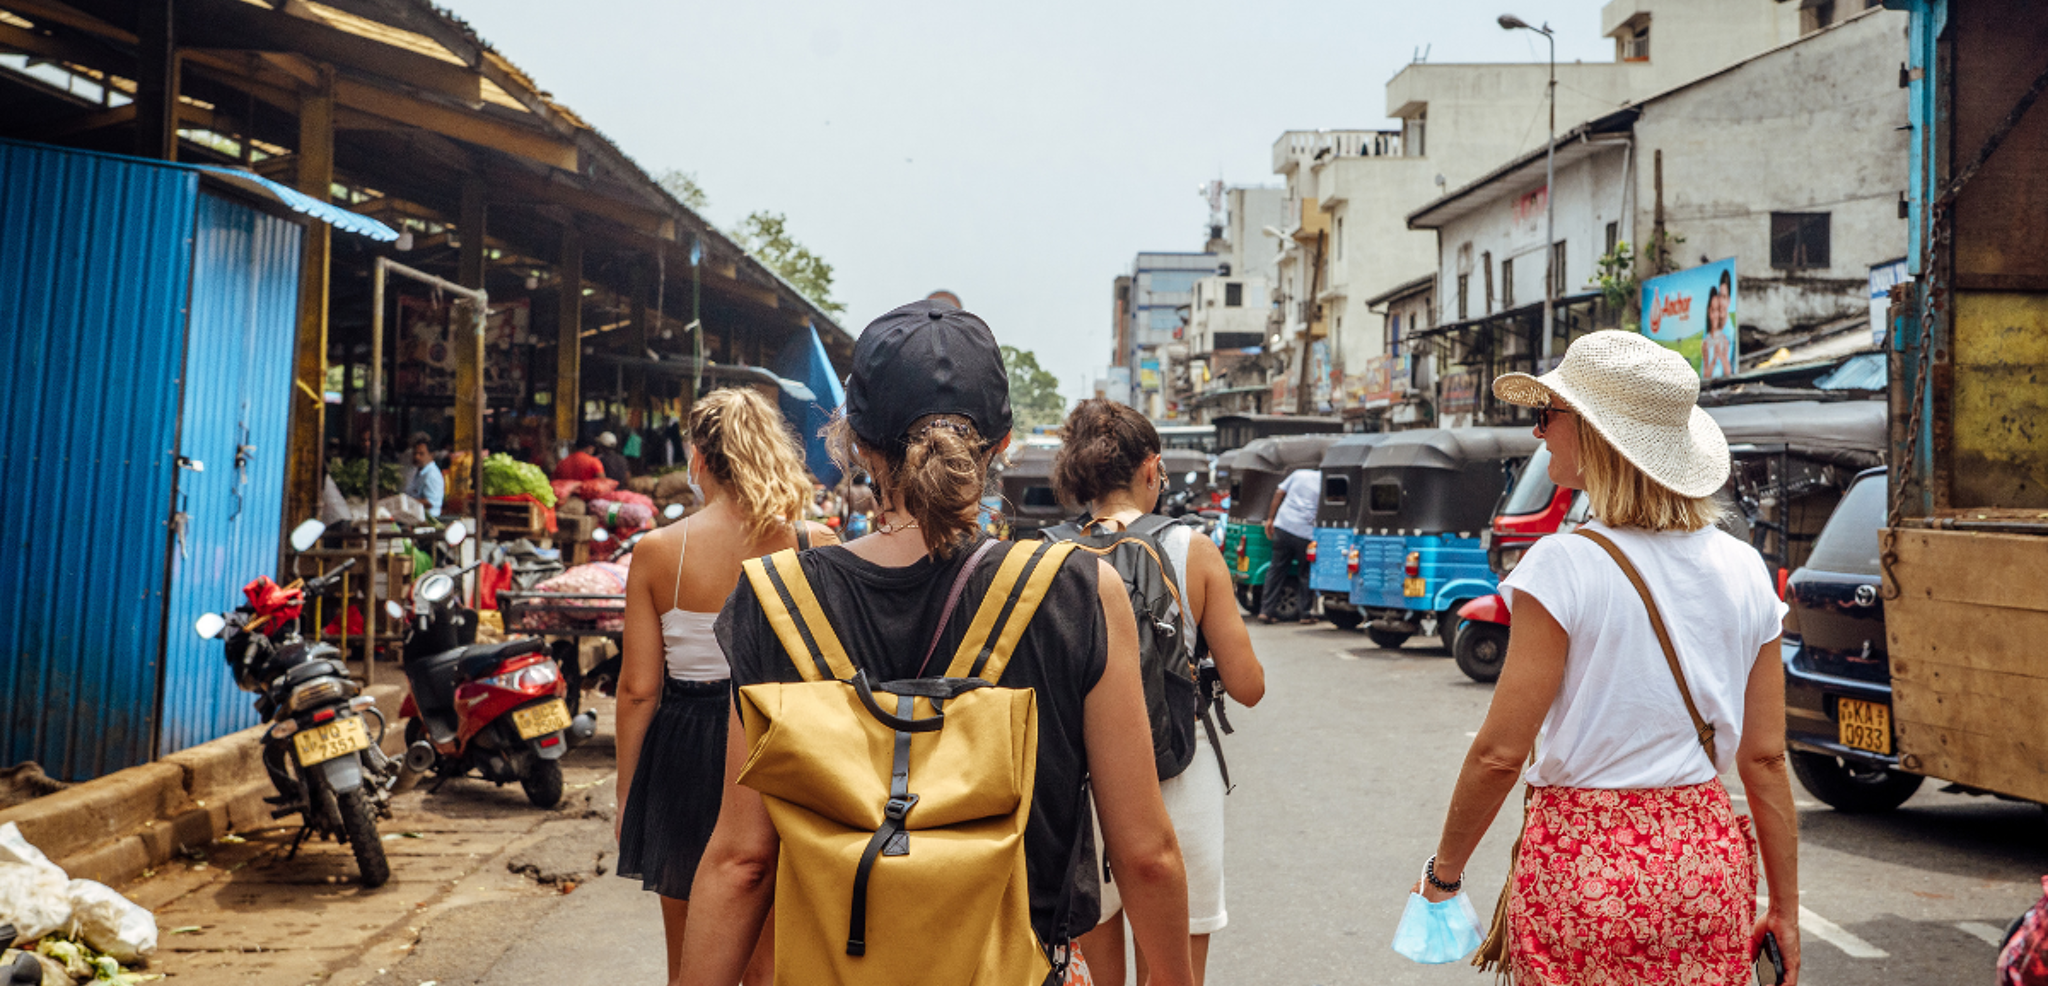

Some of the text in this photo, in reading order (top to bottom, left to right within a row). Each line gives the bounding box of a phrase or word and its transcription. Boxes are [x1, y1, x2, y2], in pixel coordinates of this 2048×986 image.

[1661, 292, 1692, 317] Anchor
[1853, 701, 1874, 725] KA
[317, 724, 340, 742] WQ
[1845, 723, 1883, 750] 0933
[319, 736, 356, 757] 7351
